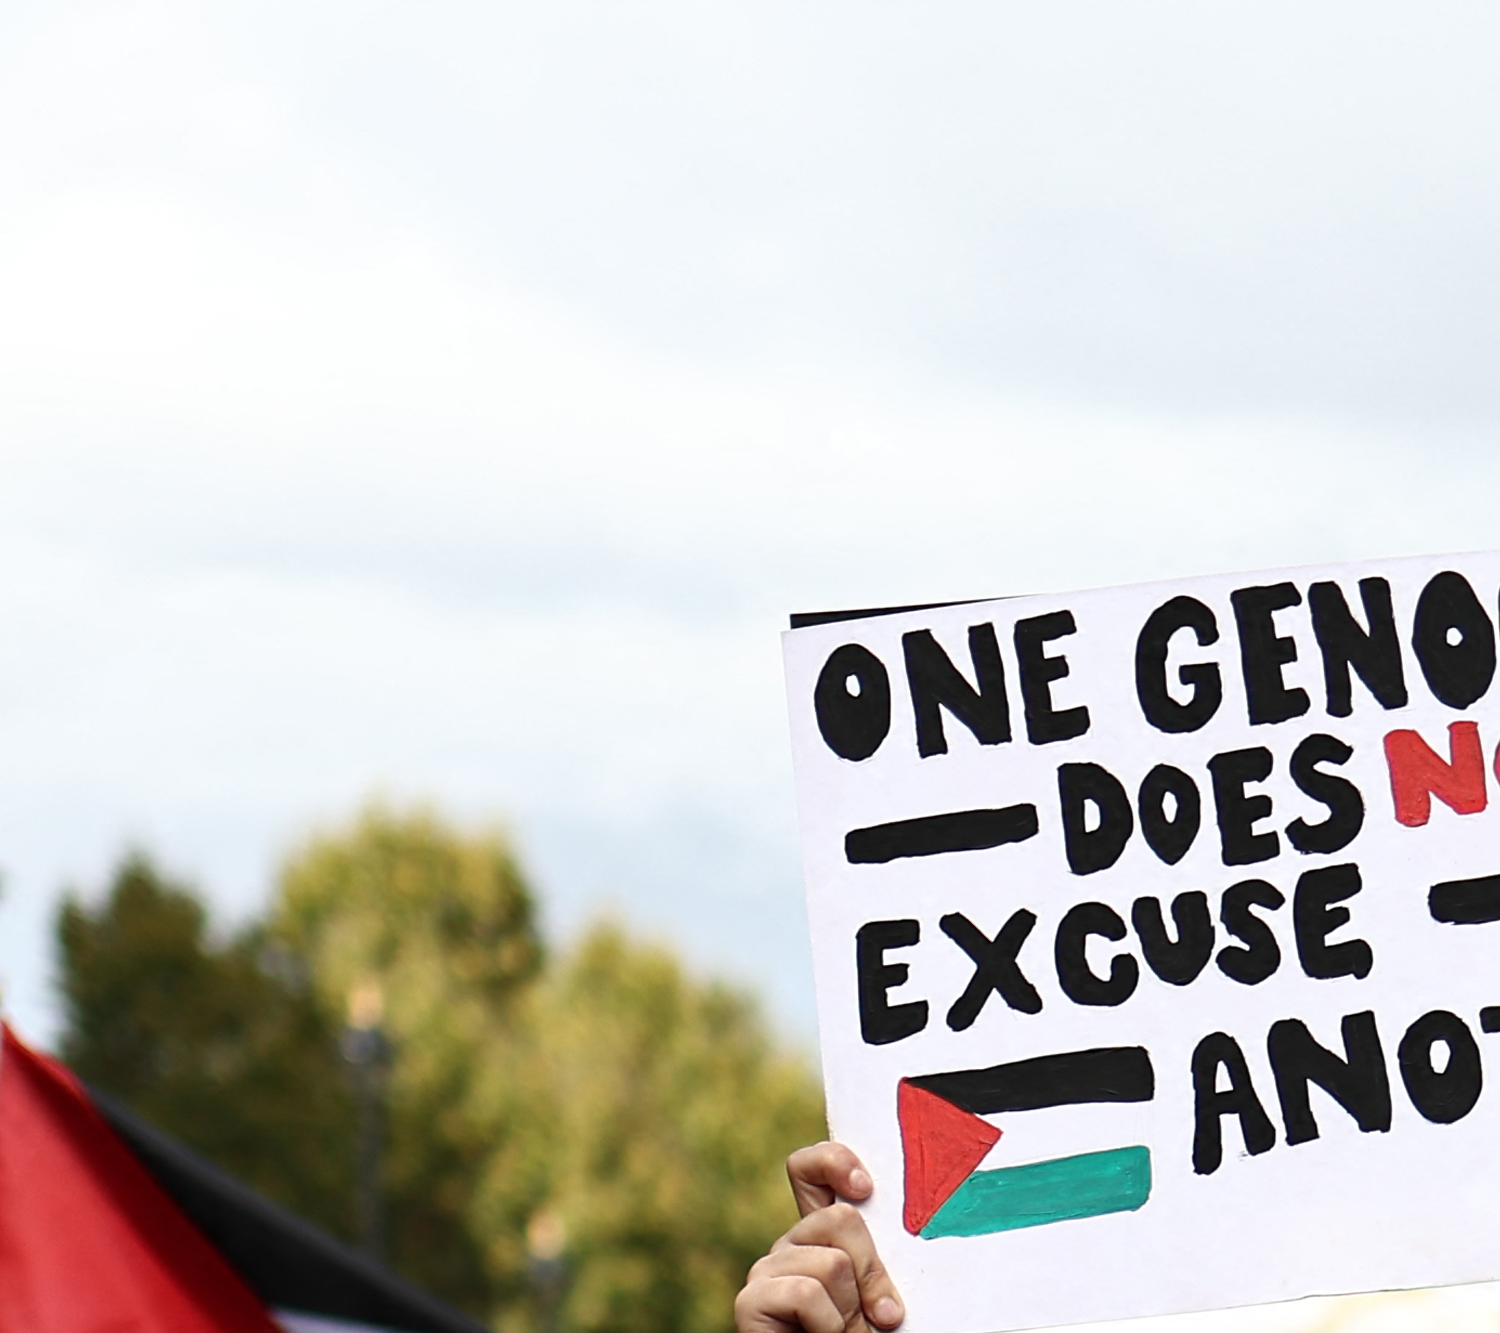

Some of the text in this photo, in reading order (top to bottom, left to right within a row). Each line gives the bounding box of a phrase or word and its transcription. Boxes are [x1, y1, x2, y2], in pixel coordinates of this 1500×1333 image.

[813, 609, 1091, 762] ONE
[1056, 733, 1366, 876] DOES
[854, 862, 1375, 1046] EXCUSE
